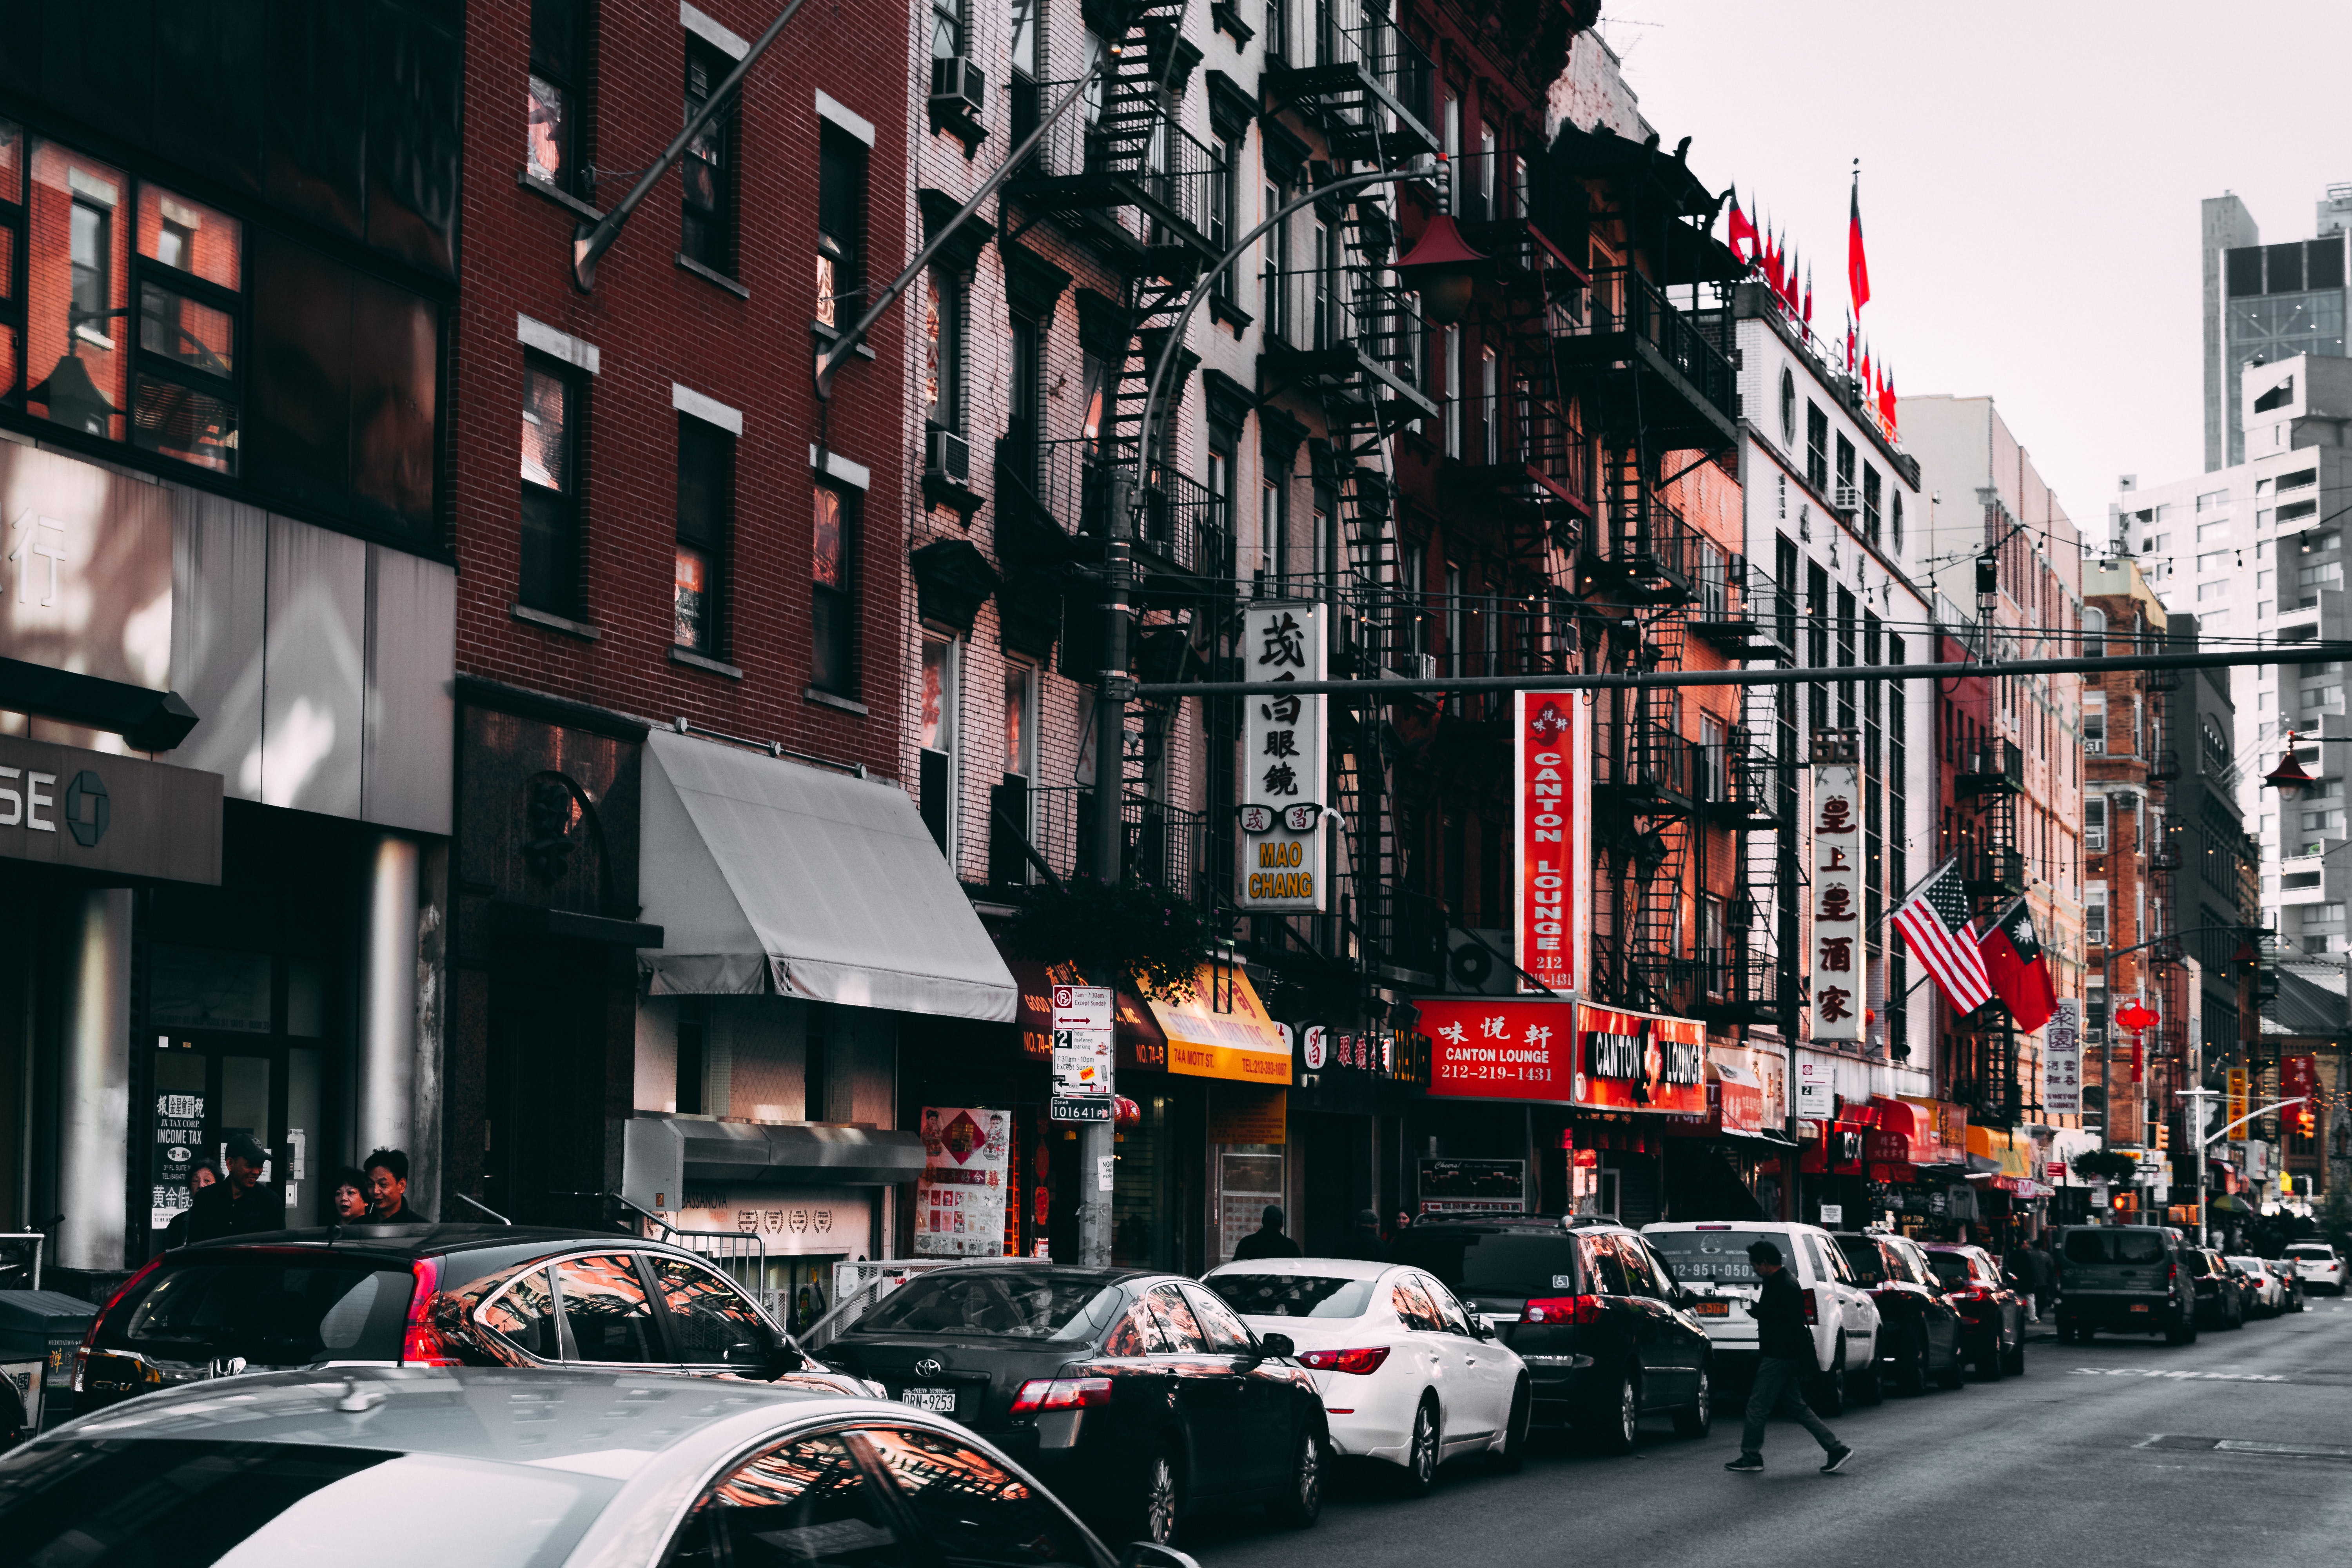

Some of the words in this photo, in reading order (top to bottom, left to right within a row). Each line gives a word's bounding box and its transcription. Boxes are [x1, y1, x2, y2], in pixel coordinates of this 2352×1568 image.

[0, 508, 65, 607] 行
[1259, 612, 1305, 795] 茂昌眼鏡
[1535, 753, 1563, 842] CANTON
[1259, 841, 1302, 869] MAO
[1249, 871, 1313, 900] CHANG
[1535, 860, 1563, 951] LOUNGE
[1536, 956, 1562, 969] 212
[1025, 994, 1050, 1013] GOOD
[1121, 1007, 1142, 1024] INC.
[1059, 1031, 1067, 1047] 2
[1168, 1012, 1217, 1039] SILVER
[1243, 1024, 1273, 1046] INC.
[1024, 1031, 1036, 1053] NO.
[1037, 1034, 1053, 1054] 74-B
[1136, 1044, 1147, 1063] NO.
[1149, 1046, 1164, 1065] 74-B
[1174, 1048, 1186, 1063] 74A
[1187, 1050, 1204, 1066] MOTT
[1205, 1053, 1214, 1068] ST.
[1446, 1048, 1495, 1061] CANTON
[1500, 1049, 1549, 1063] LOUNGE
[1596, 1031, 1640, 1078] CANTON
[1666, 1041, 1703, 1084] LOUNGE
[1441, 1065, 1552, 1081] 212-219-1431
[1054, 1107, 1094, 1117] 101641
[158, 1129, 186, 1144] INCOME
[189, 1130, 202, 1144] TAX
[682, 1191, 728, 1209] BASSANOVA
